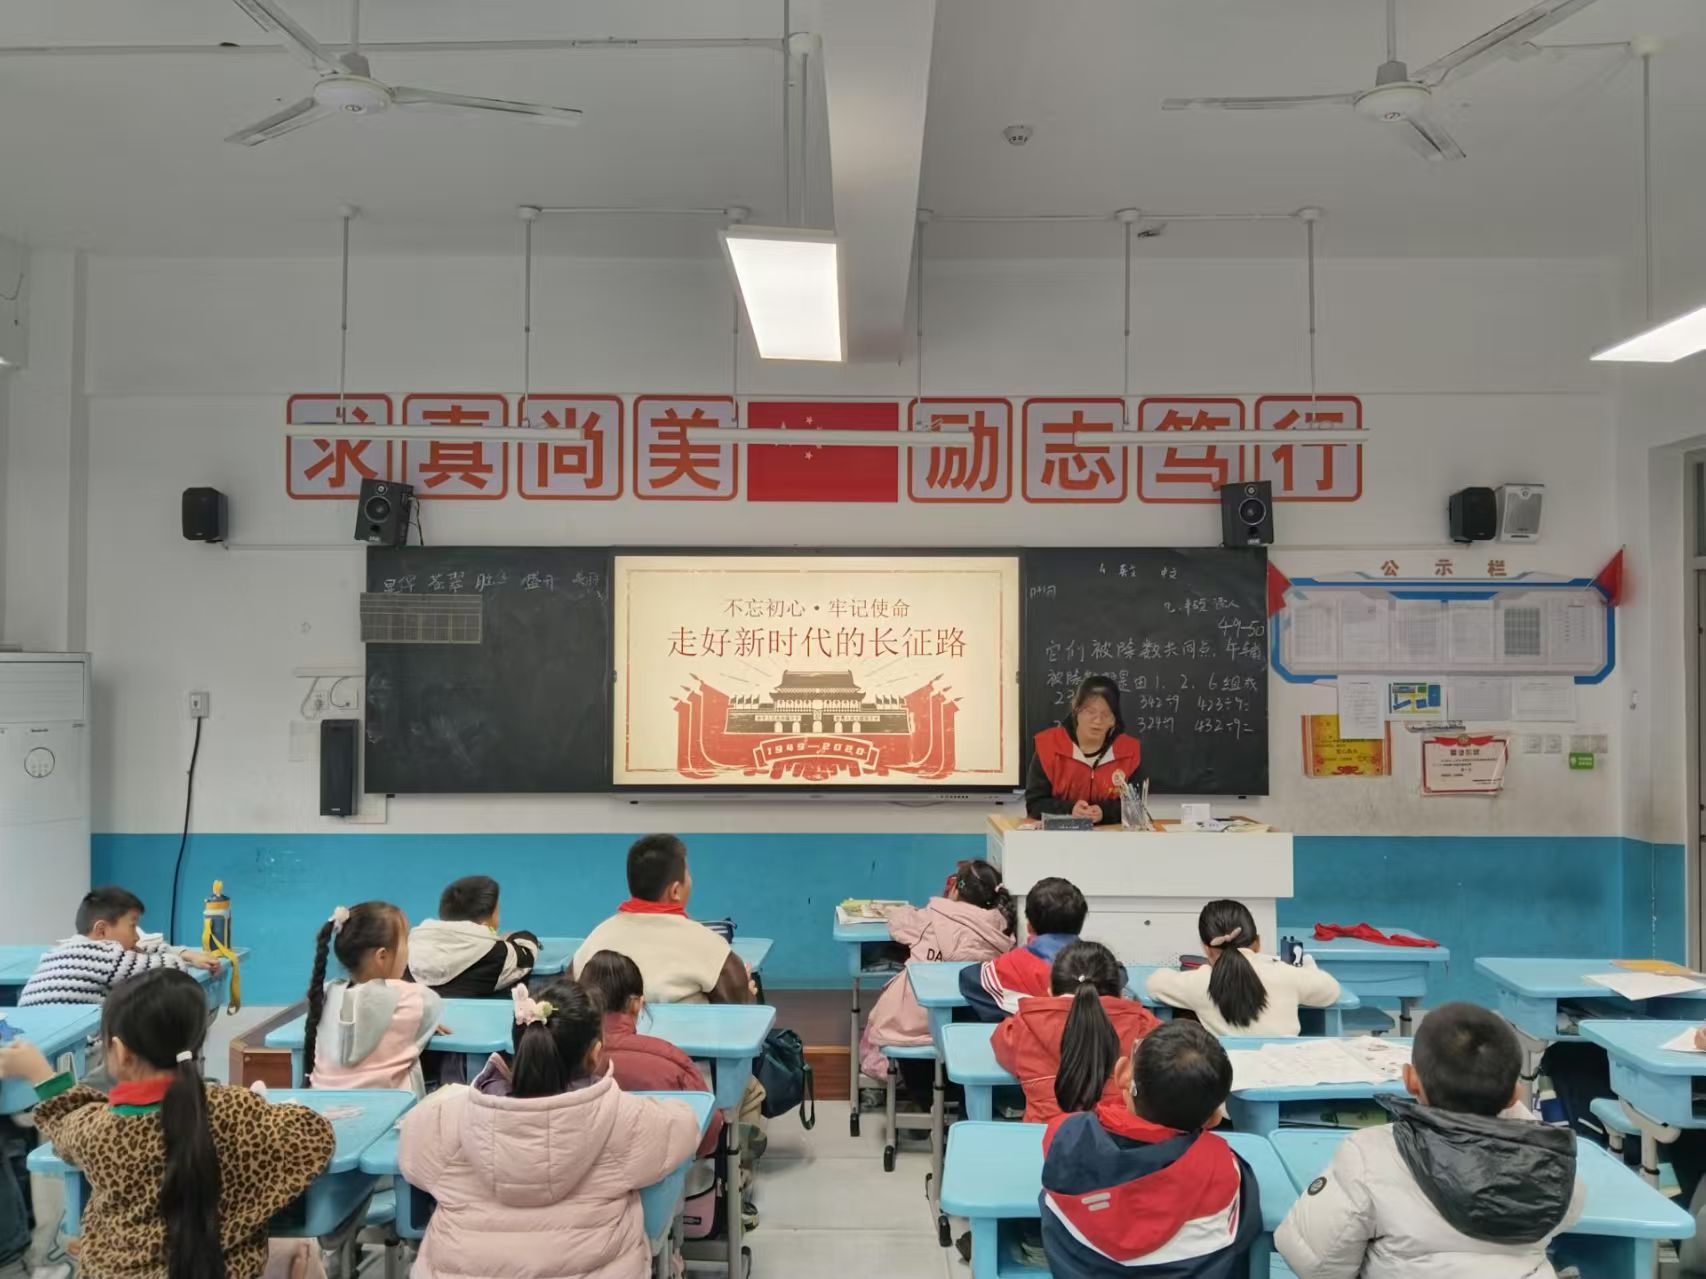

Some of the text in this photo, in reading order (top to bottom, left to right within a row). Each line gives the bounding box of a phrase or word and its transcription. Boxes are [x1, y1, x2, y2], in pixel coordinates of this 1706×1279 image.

[303, 404, 721, 490] 求真尚美
[926, 408, 1348, 491] 励志笃行
[1380, 559, 1508, 577] 公示栏
[667, 626, 967, 659] 走好新时代的长征路
